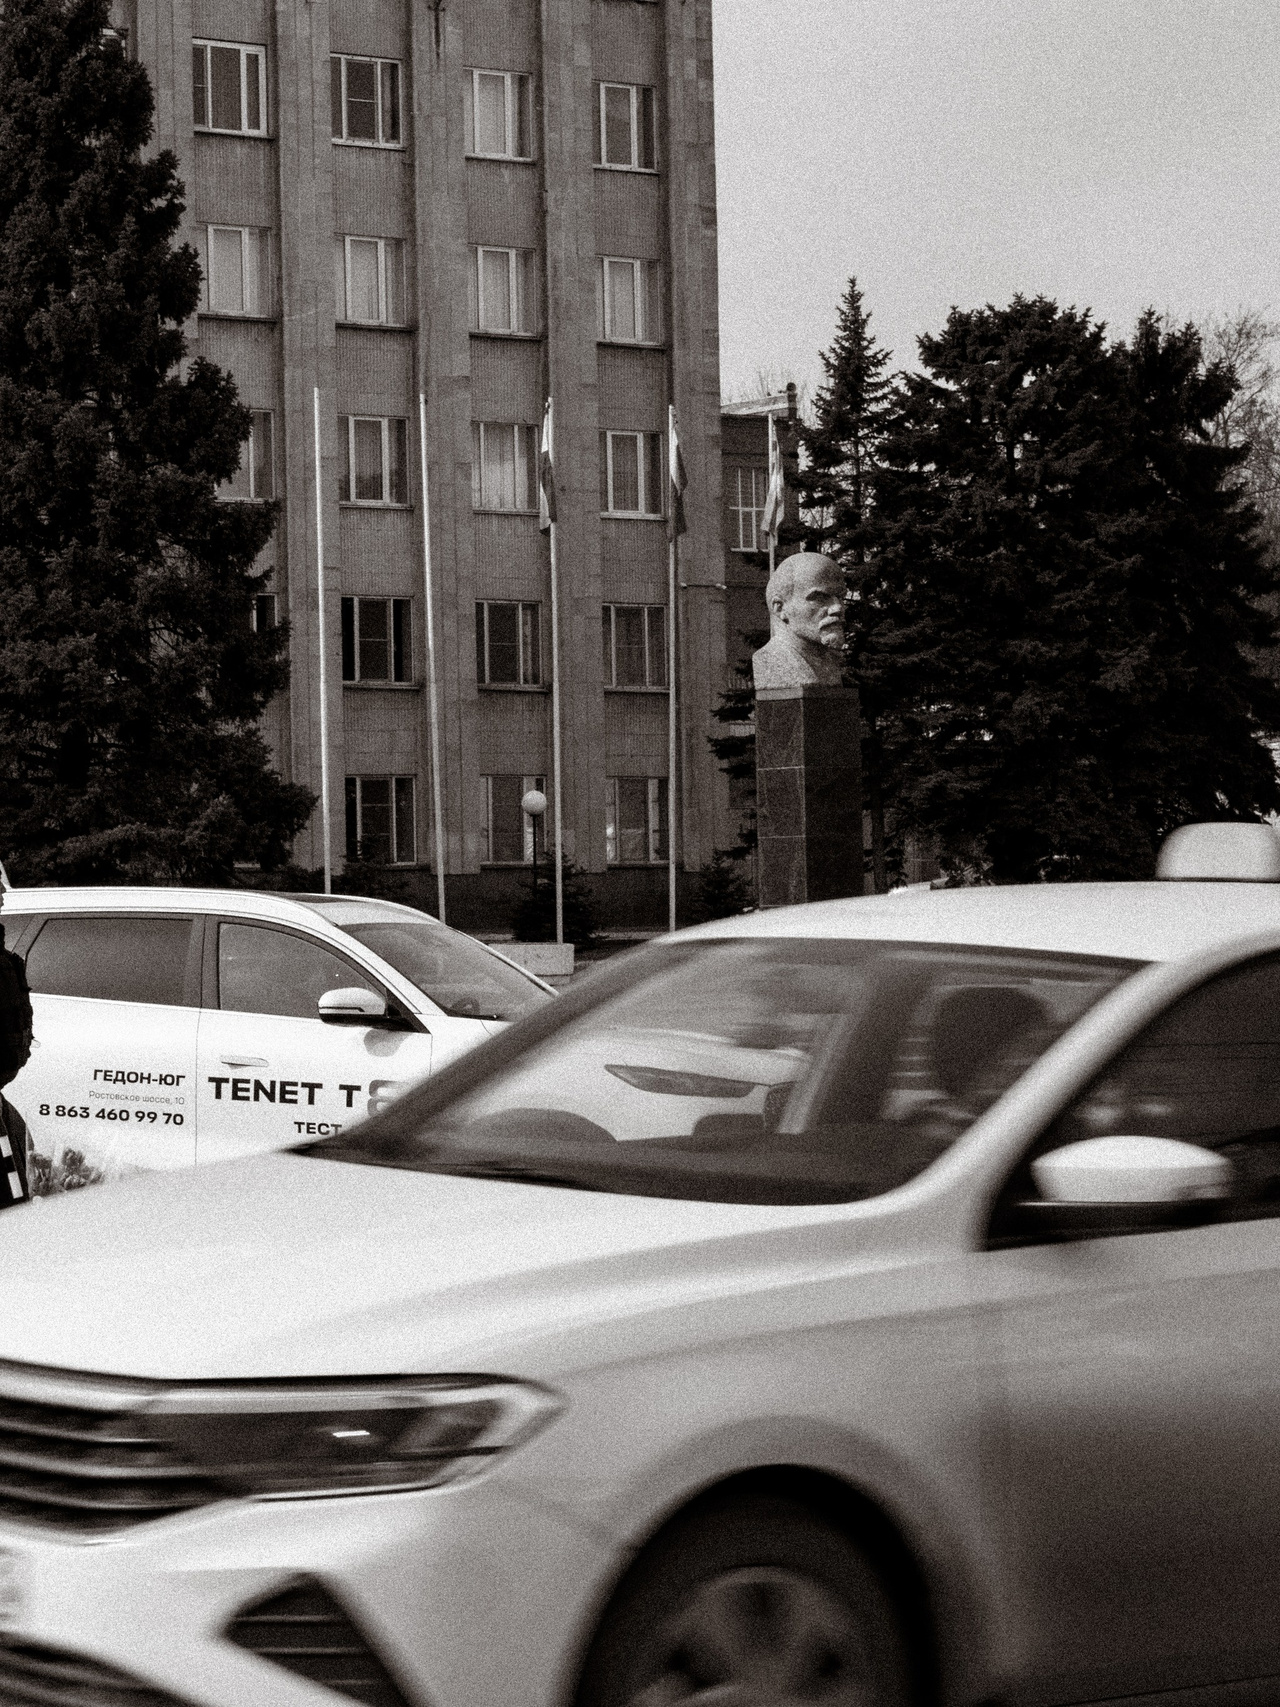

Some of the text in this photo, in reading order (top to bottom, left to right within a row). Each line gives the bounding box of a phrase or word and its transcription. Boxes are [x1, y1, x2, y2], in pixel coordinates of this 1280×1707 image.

[93, 1068, 186, 1087] ГЕДОН-ЮГ
[88, 1090, 140, 1102] Ростовское
[175, 1096, 185, 1105] 10
[207, 1076, 324, 1106] TENET
[38, 1103, 185, 1126] 8 863 460 99 70
